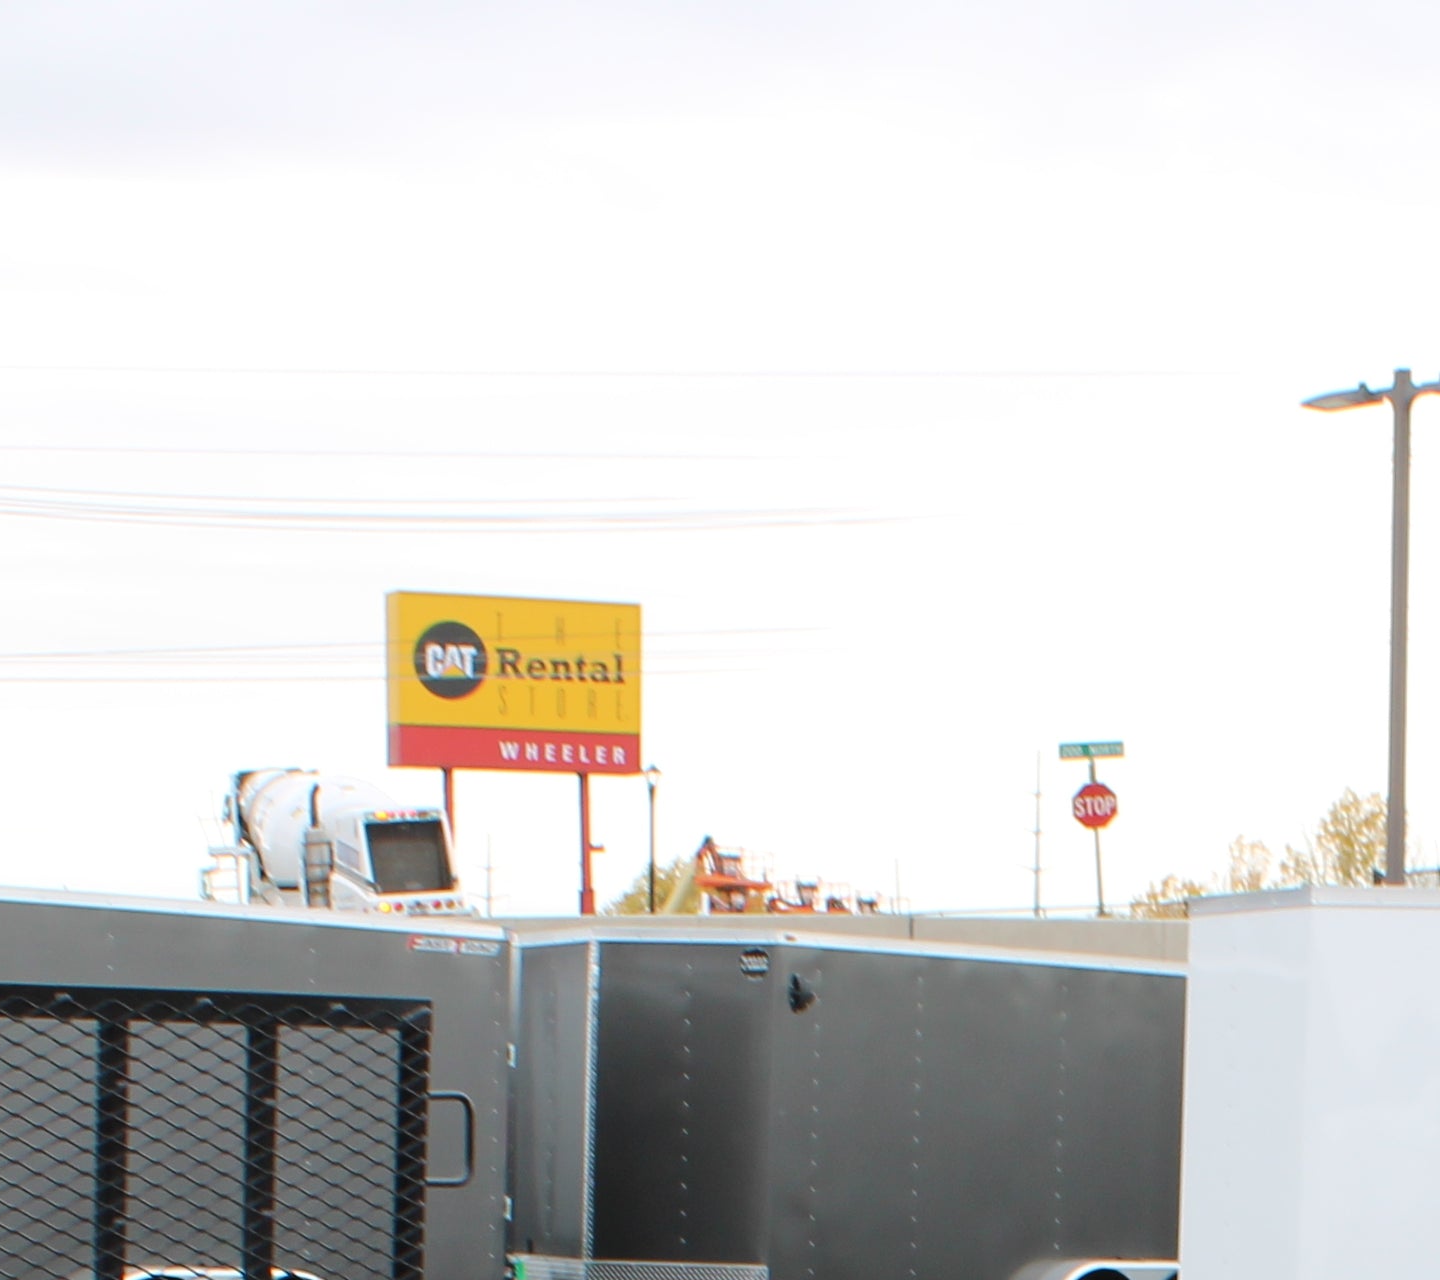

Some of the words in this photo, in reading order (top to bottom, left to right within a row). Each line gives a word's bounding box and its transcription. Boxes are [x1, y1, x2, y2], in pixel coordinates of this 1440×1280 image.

[424, 640, 478, 679] CAT
[495, 647, 626, 684] Rental
[497, 685, 623, 722] STORE
[499, 740, 627, 765] WHEELER
[1073, 795, 1116, 818] STOP
